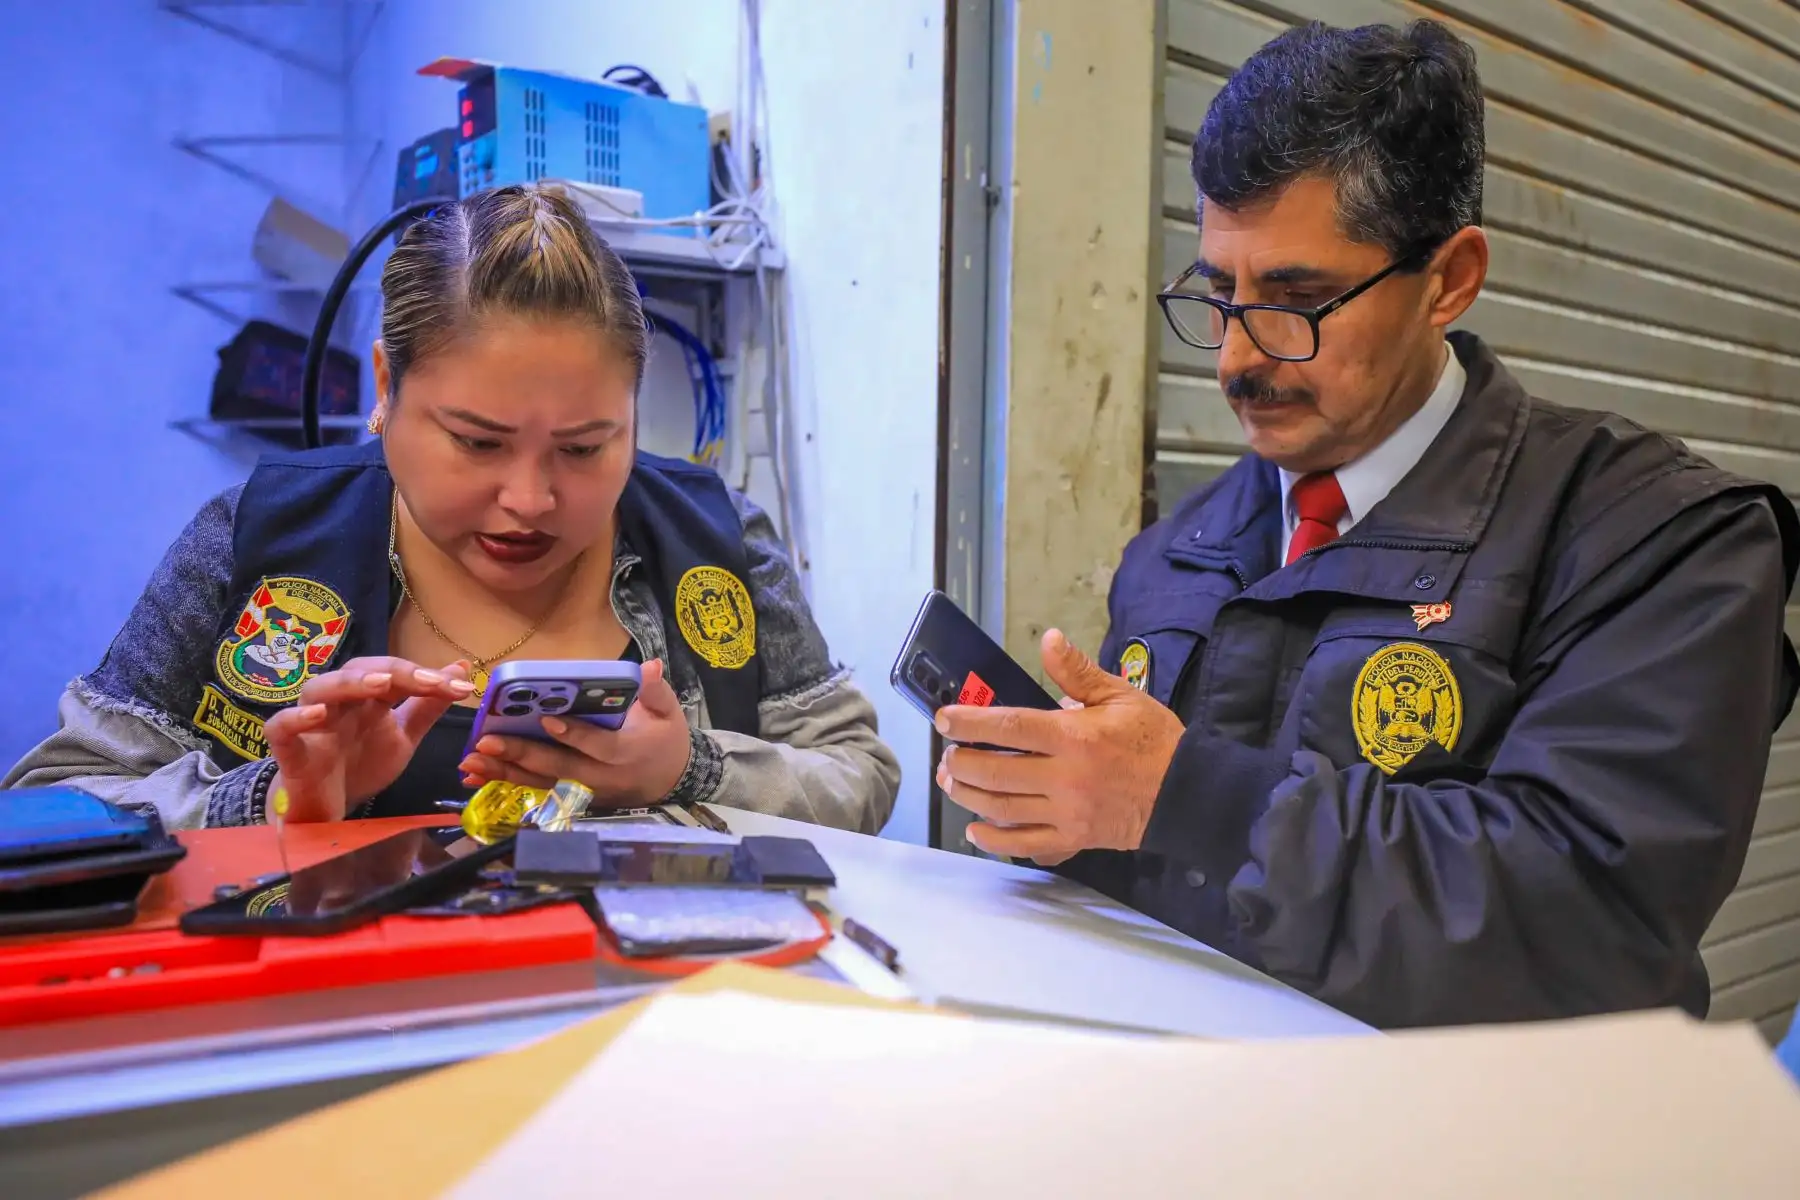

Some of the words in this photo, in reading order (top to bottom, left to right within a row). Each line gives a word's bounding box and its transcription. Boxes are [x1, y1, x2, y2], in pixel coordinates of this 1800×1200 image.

[276, 581, 308, 591] POLICIA
[310, 586, 341, 613] NACIONAL
[291, 589, 306, 599] DEL
[308, 594, 326, 609] PERU
[1369, 655, 1398, 682] POLICIA
[1401, 652, 1445, 684] NACIONAL
[1388, 666, 1402, 677] DEL
[1404, 664, 1425, 678] PERU
[208, 694, 218, 714] D.
[206, 714, 243, 748] SUBOFICIAL
